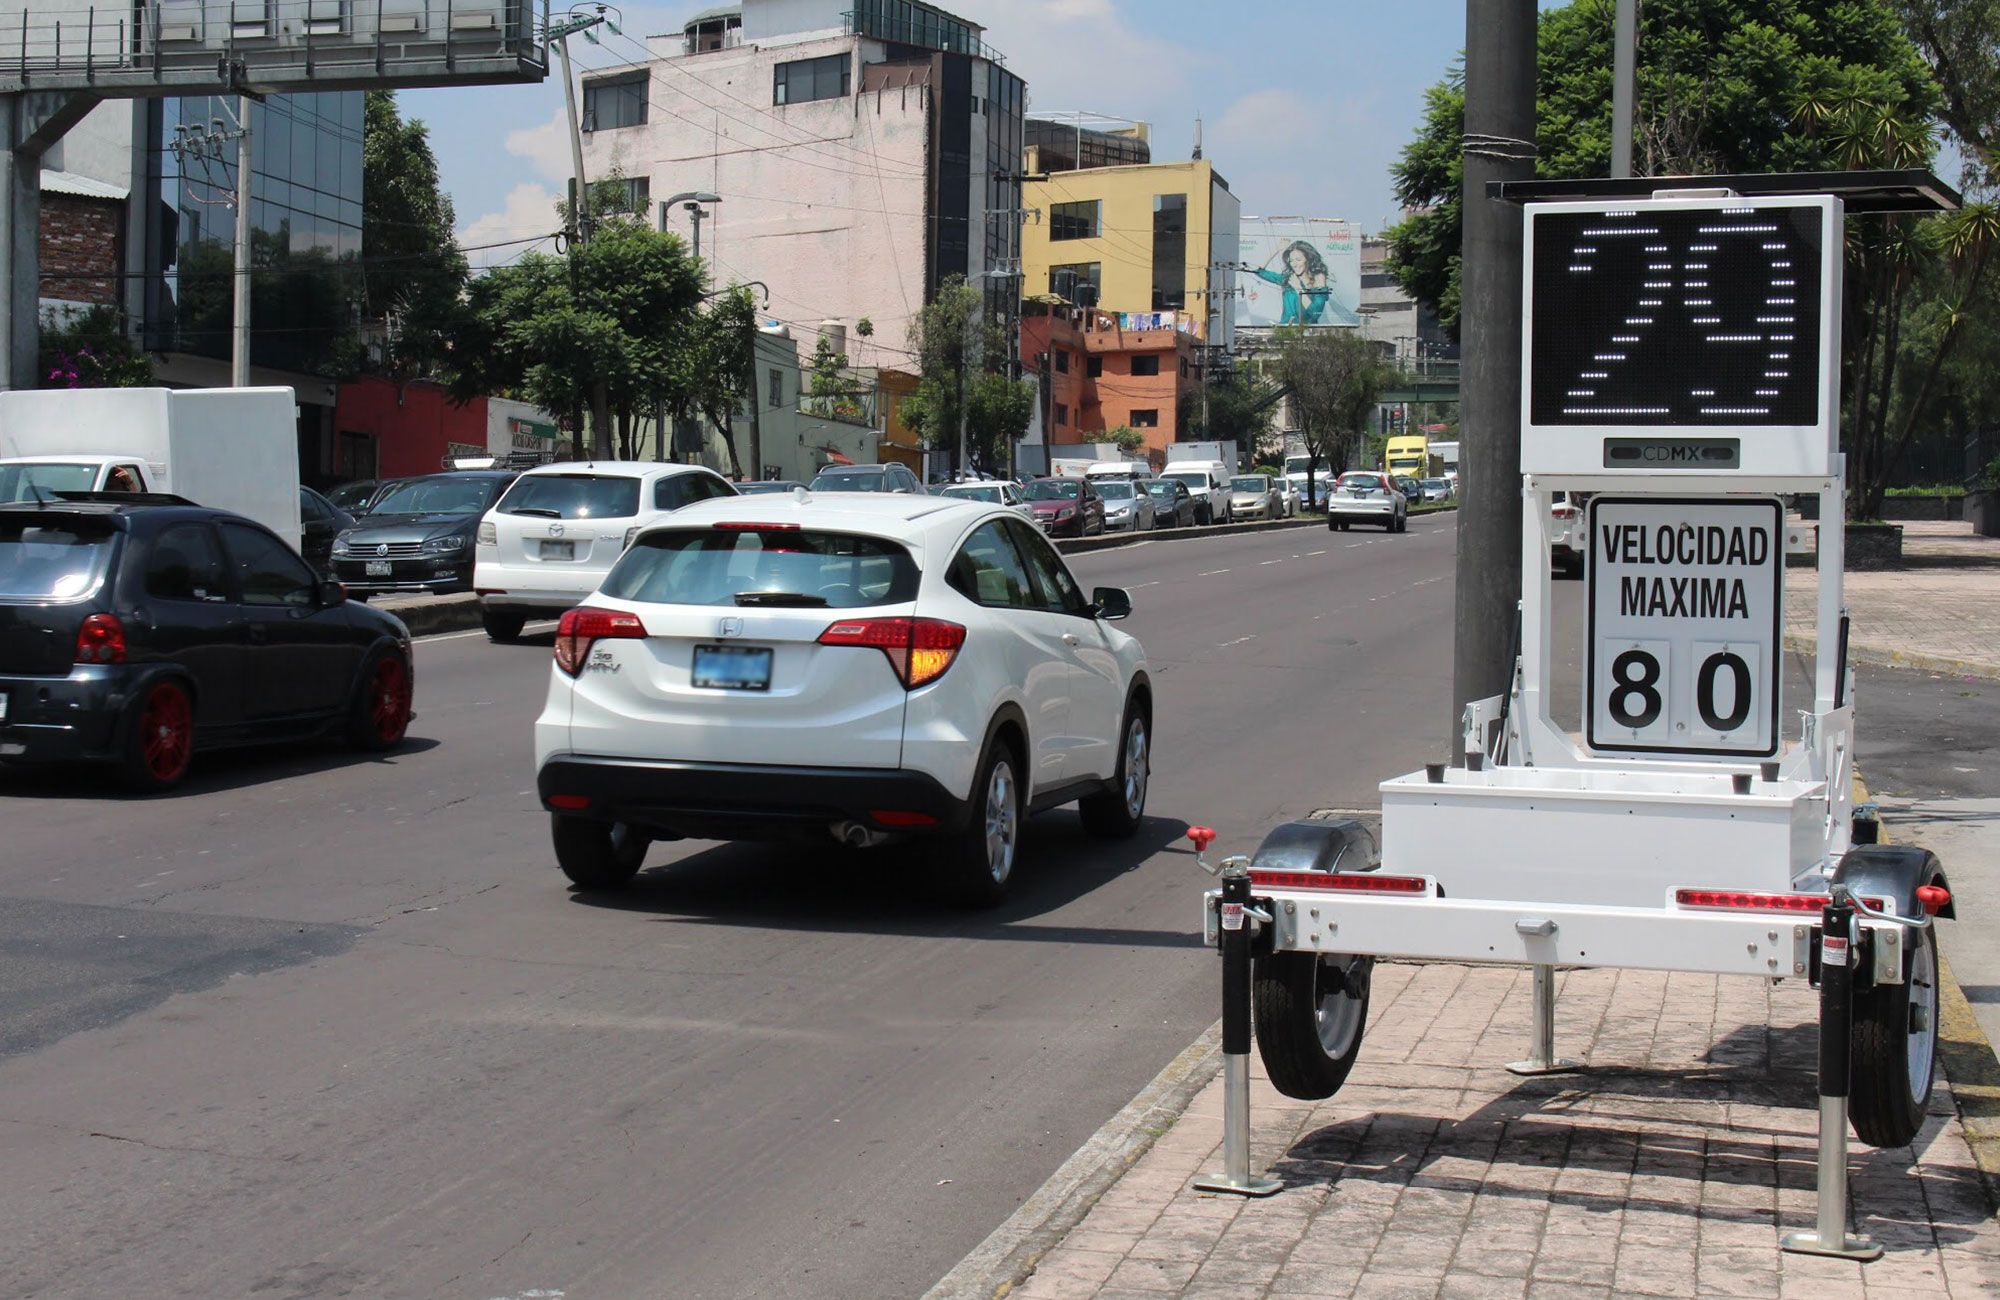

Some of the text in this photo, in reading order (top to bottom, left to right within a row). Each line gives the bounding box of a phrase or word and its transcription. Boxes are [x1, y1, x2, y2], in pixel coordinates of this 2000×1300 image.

[1562, 208, 1796, 414] 29
[1643, 446, 1700, 461] CDMX
[1602, 524, 1768, 566] VELOCIDAD
[1620, 576, 1749, 619] MAXIMA
